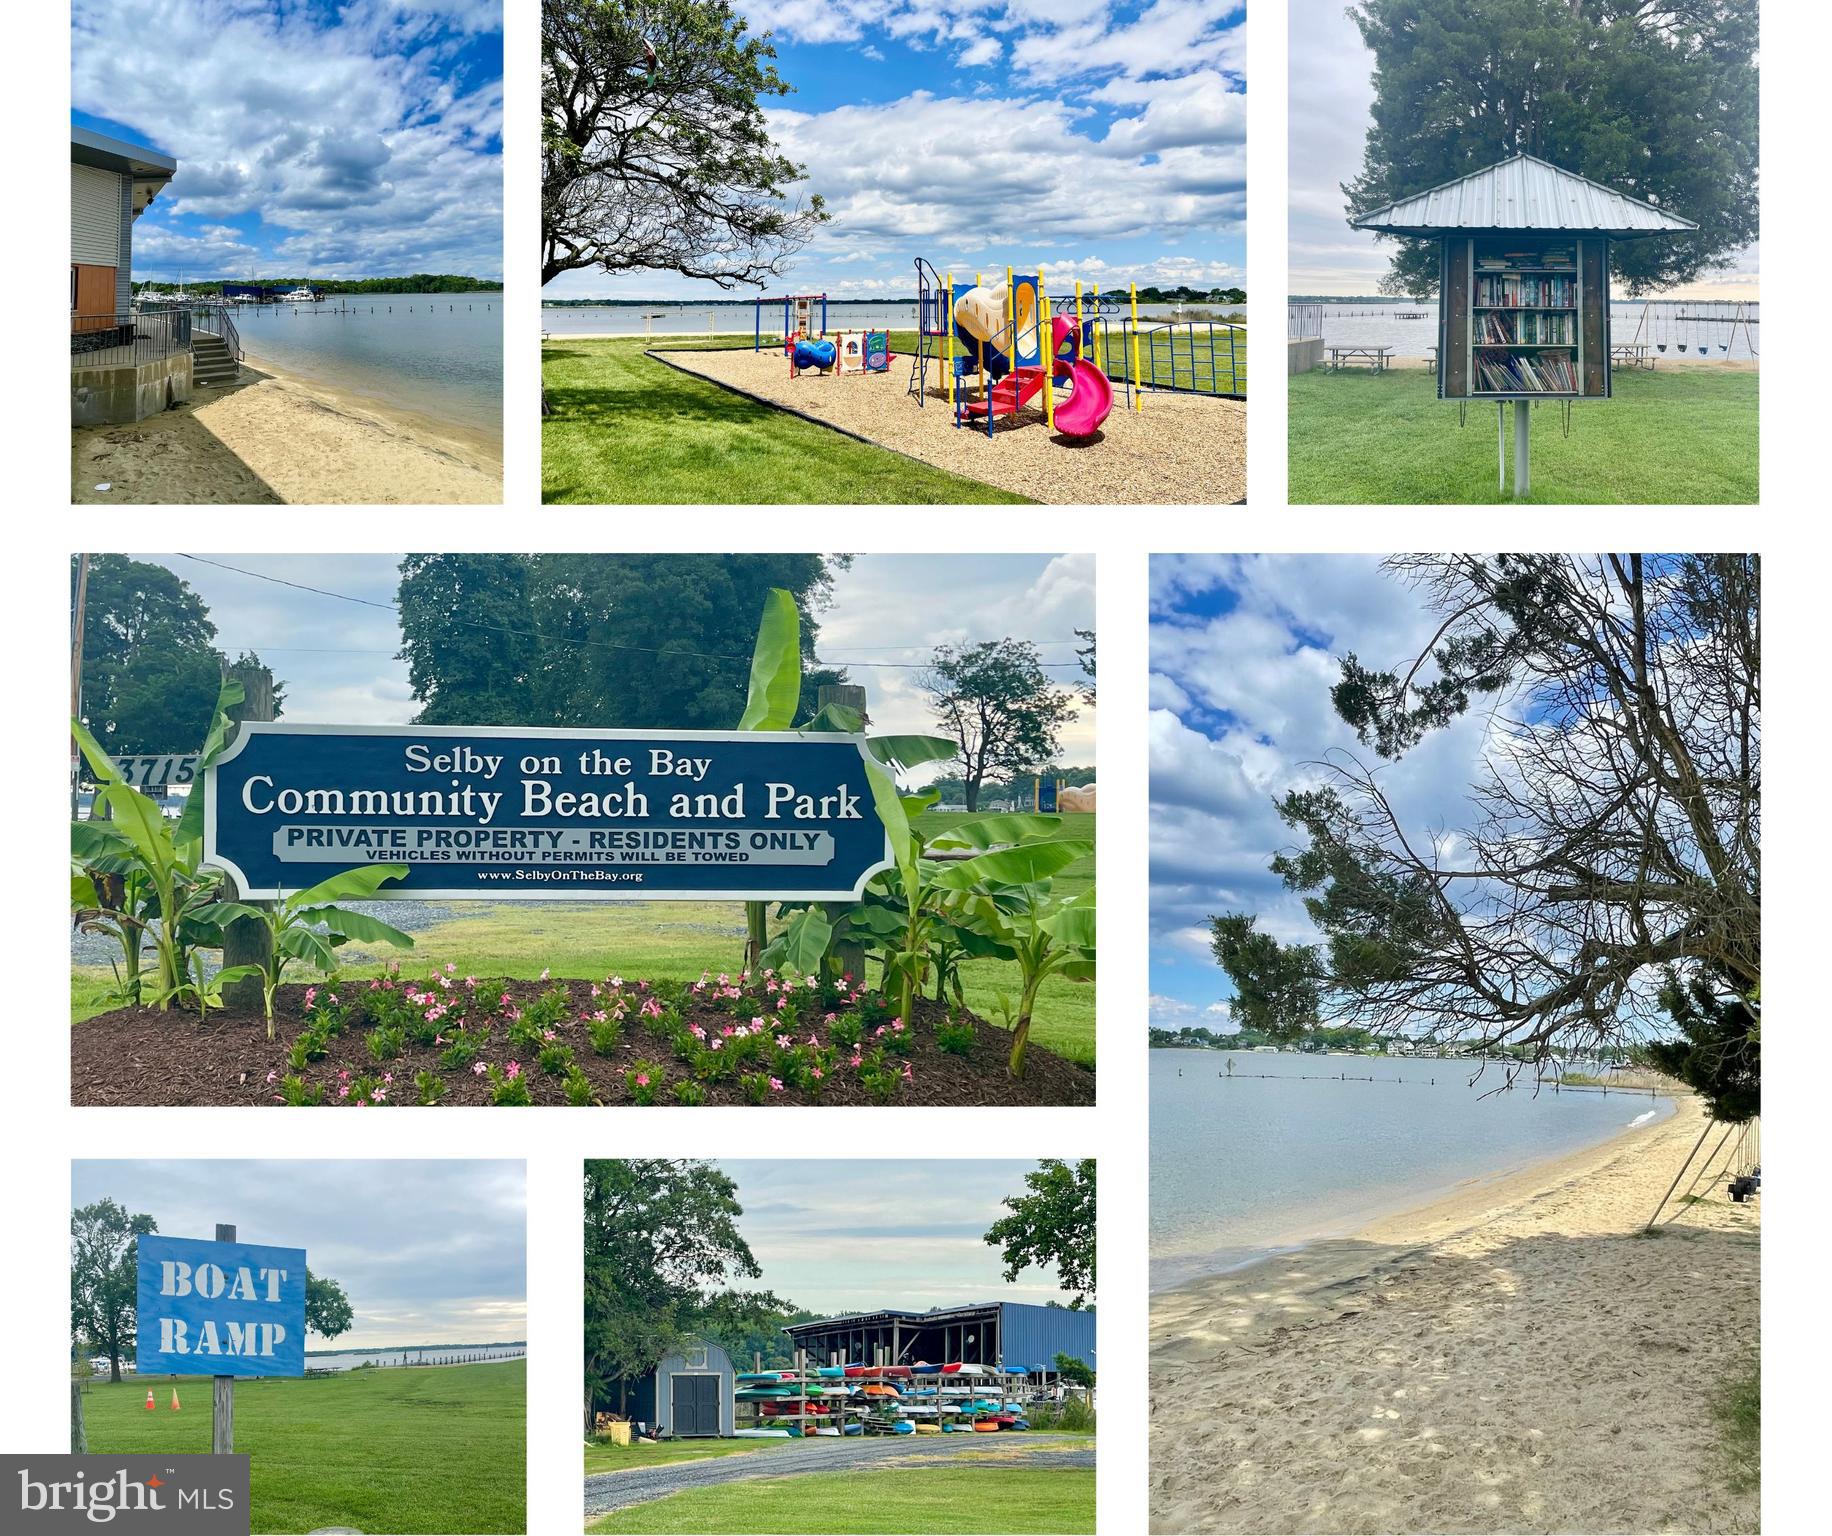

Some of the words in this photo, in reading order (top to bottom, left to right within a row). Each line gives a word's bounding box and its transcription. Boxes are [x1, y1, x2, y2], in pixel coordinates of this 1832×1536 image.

[118, 758, 197, 784] 3715
[405, 745, 504, 780] Selby
[520, 756, 562, 776] on
[579, 749, 632, 776] the
[649, 749, 712, 780] Bay
[241, 775, 503, 825] Community
[520, 779, 650, 818] Beach
[670, 783, 746, 819] and
[764, 783, 864, 820] Park
[287, 828, 407, 848] PRIVATE
[417, 829, 564, 849] PROPERTY
[590, 831, 741, 850] RESIDENTS
[750, 832, 821, 851] ONLY
[366, 850, 451, 861] VEHICLES
[456, 850, 536, 862] WITHOUT
[541, 851, 615, 861] PERMITS
[620, 851, 660, 862] WILL
[665, 852, 687, 862] BE
[692, 852, 750, 863] TOWED
[477, 869, 644, 882] www.SelbyOnTheBay.org
[159, 1260, 288, 1303] BOAT
[159, 1317, 287, 1357] RAMP
